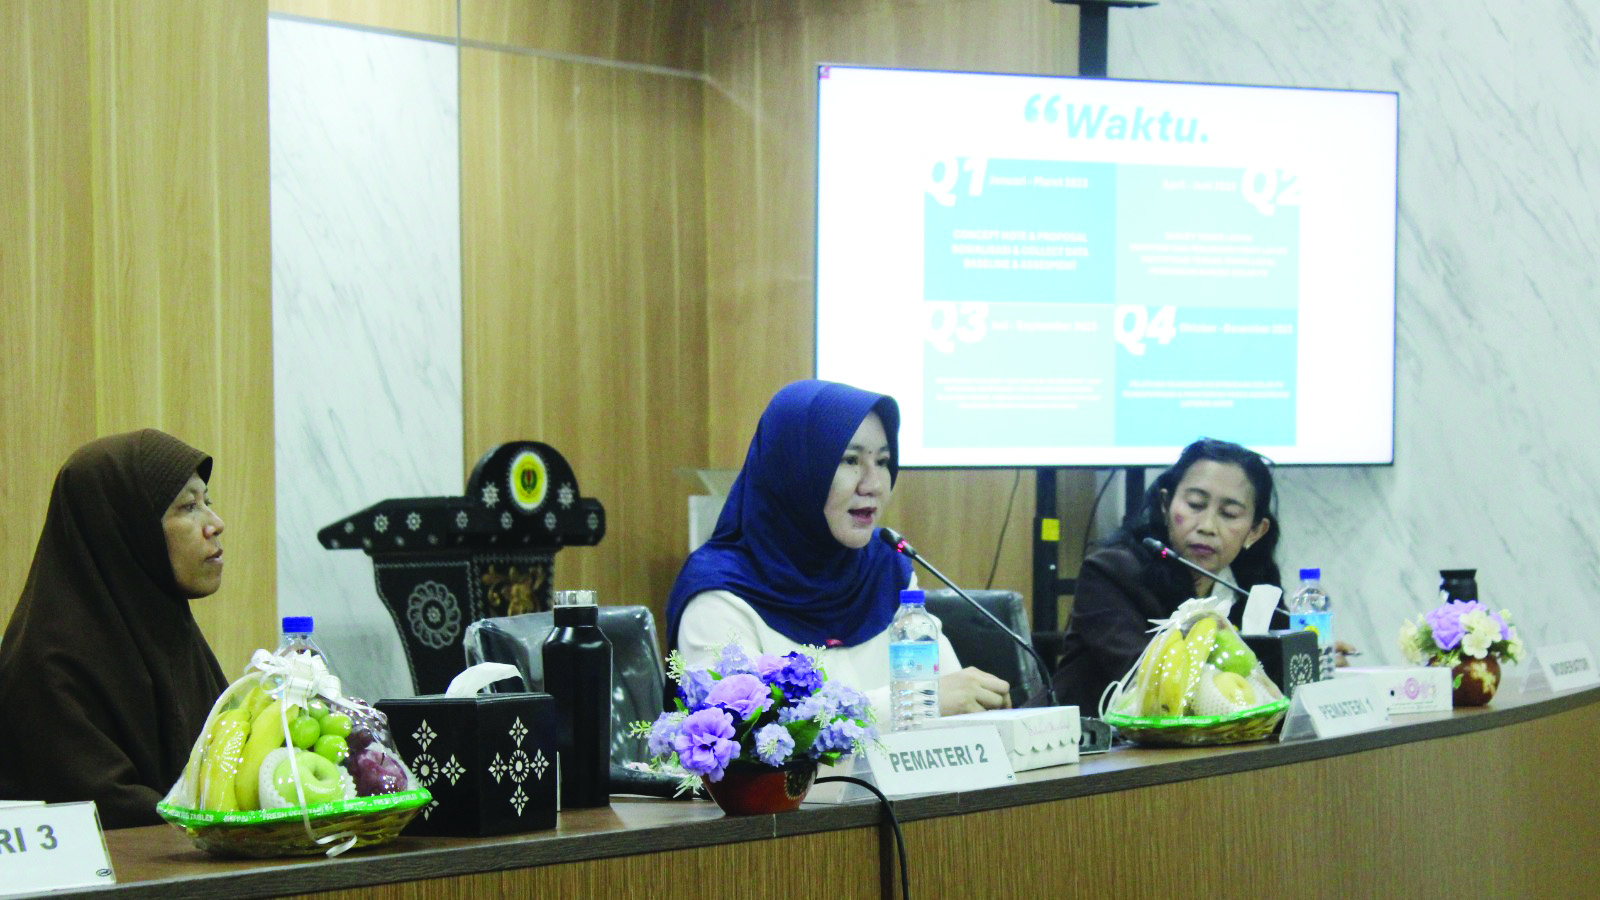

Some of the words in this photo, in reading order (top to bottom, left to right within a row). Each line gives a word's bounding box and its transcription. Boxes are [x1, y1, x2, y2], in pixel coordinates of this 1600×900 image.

[924, 155, 988, 207] Q1
[1240, 166, 1302, 216] Q2
[923, 301, 989, 353] Q3
[1114, 304, 1177, 356] Q4
[1318, 699, 1367, 719] PEMATERI
[889, 744, 974, 773] PEMATERI
[975, 743, 989, 764] 2
[36, 824, 58, 850] 3
